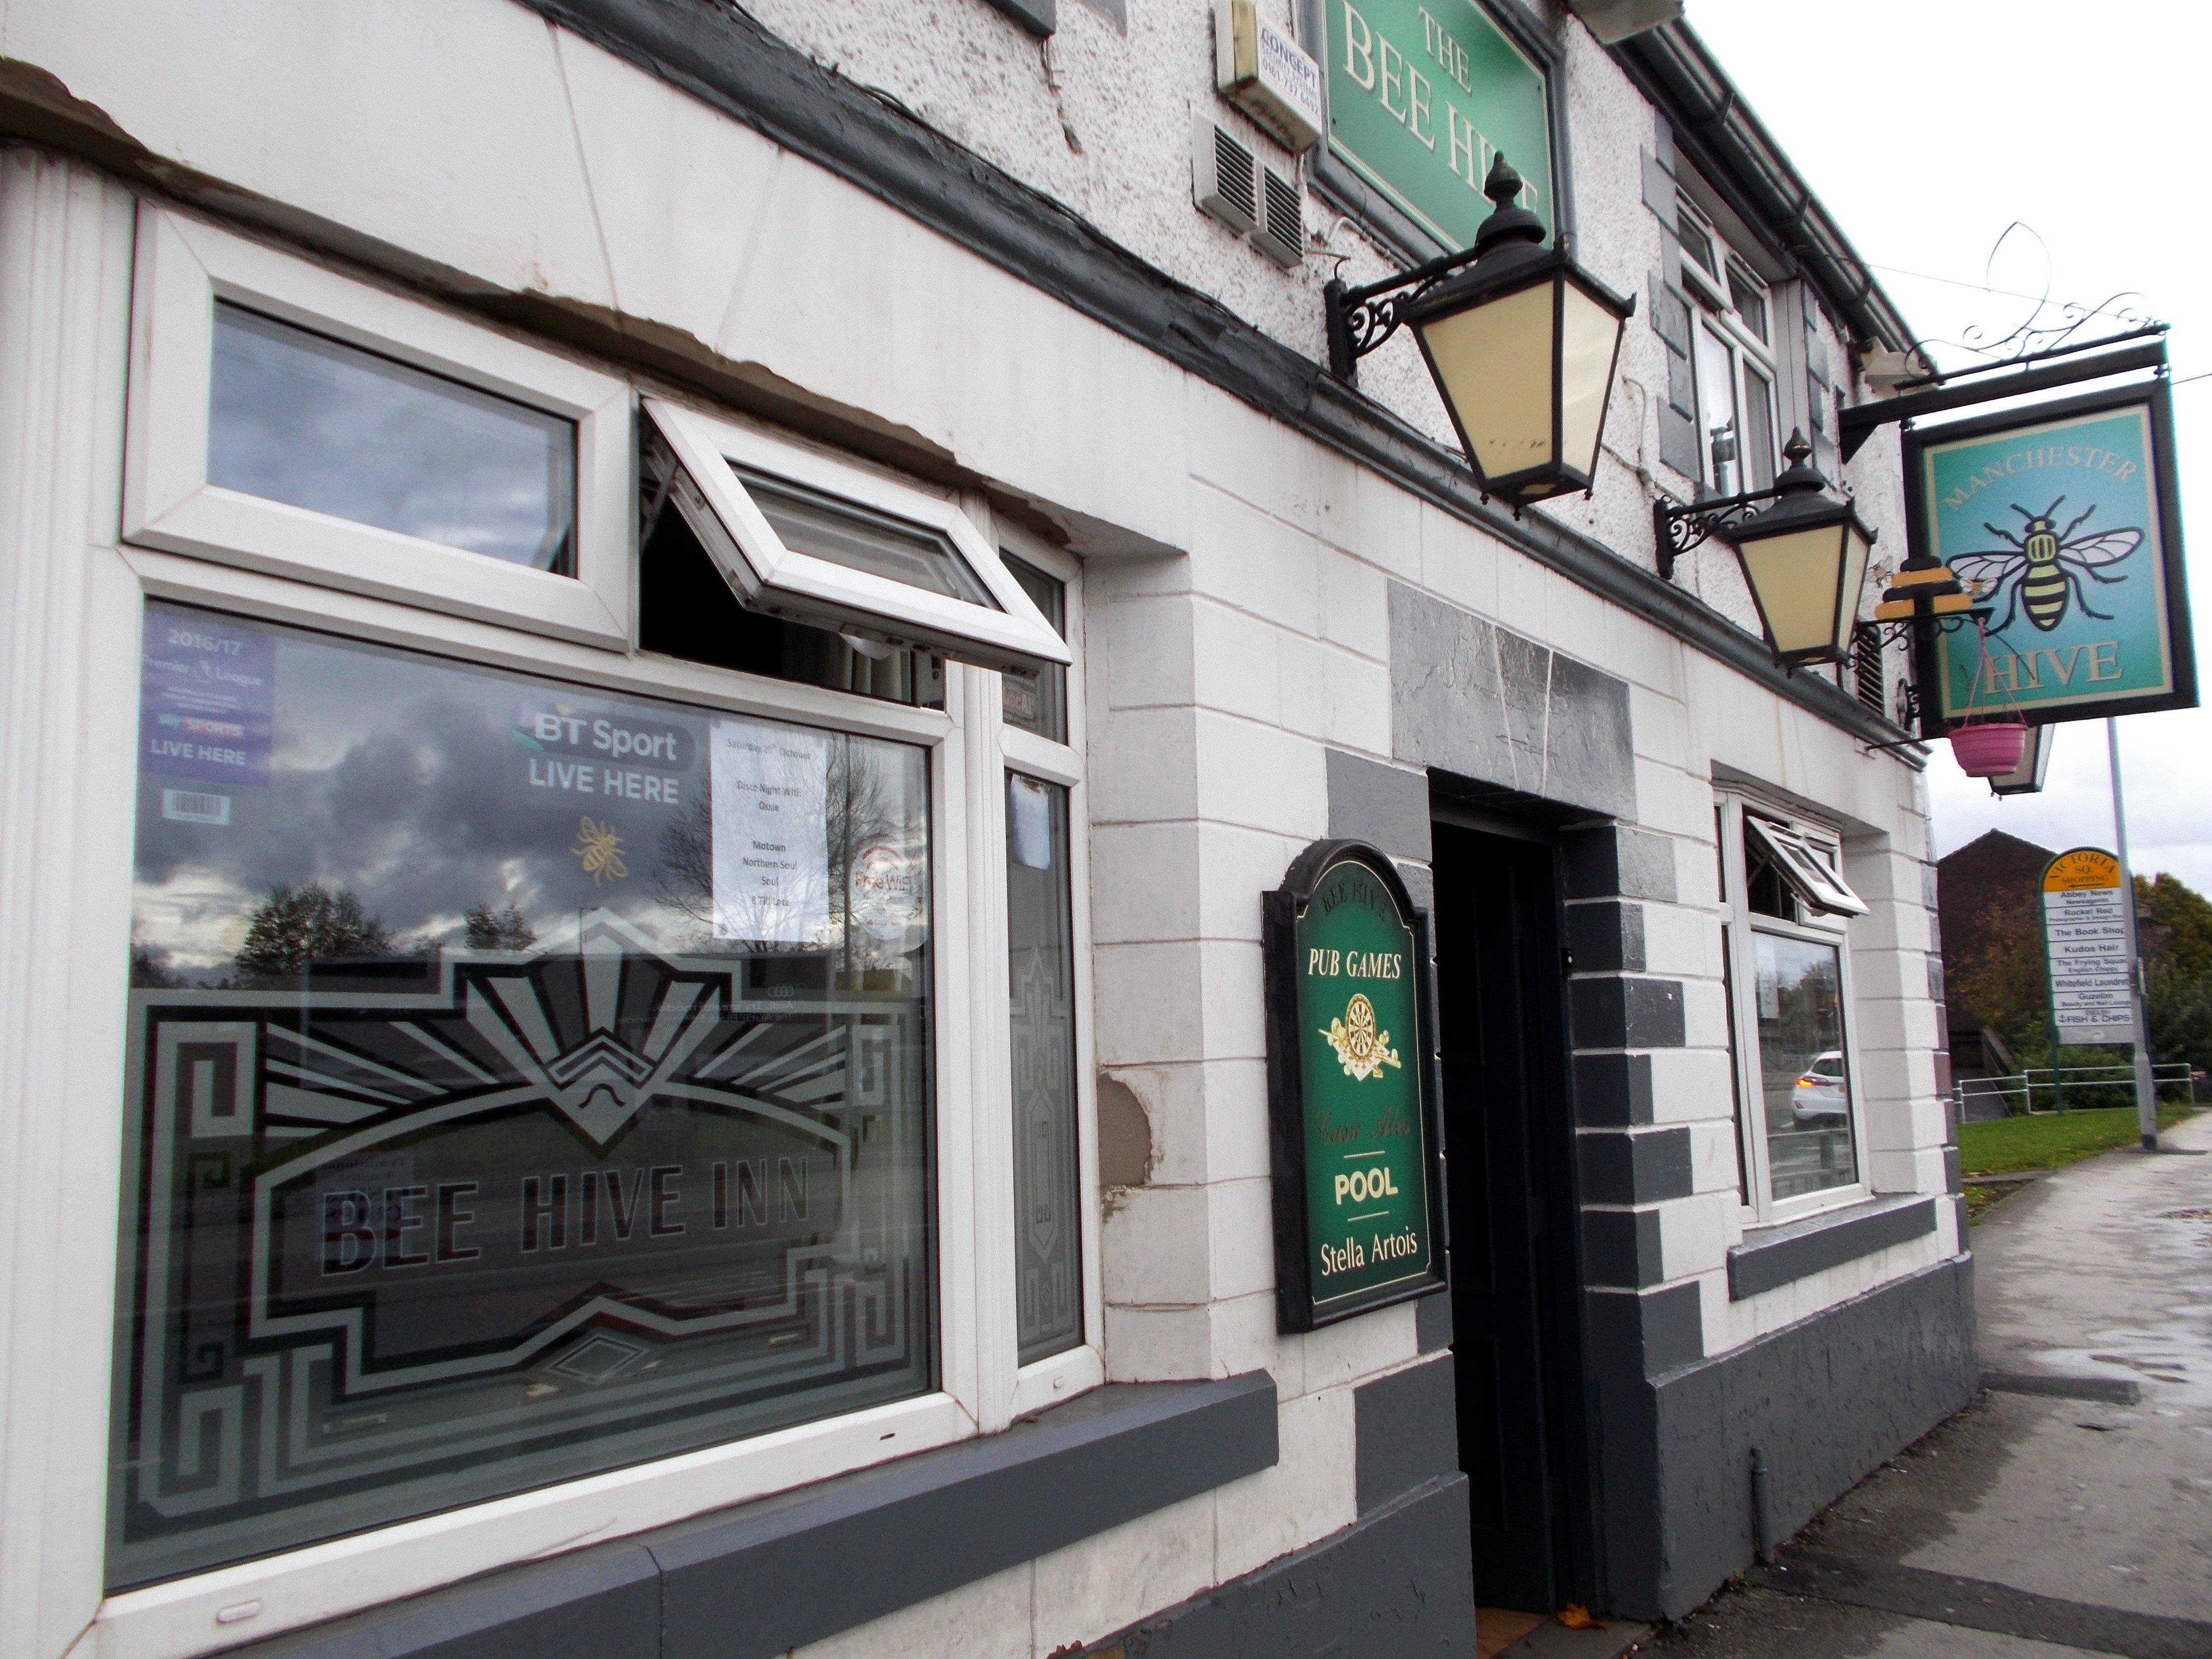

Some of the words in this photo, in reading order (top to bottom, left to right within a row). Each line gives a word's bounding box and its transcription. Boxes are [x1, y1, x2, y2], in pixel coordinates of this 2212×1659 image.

[1261, 27, 1316, 88] CONCEPT
[1418, 4, 1473, 95] THE
[1342, 0, 1436, 151] BEE
[1945, 446, 2138, 512] MANCHESTER
[167, 628, 243, 655] 2016/17
[1983, 640, 2124, 695] HIVE
[534, 712, 587, 744] BT
[592, 719, 678, 761] Sport
[152, 738, 193, 758] LIVE
[197, 744, 247, 766] HERE
[779, 747, 811, 759] October
[529, 757, 594, 793] LIVE
[603, 768, 680, 805] HERE
[737, 780, 757, 792] Disco
[759, 783, 781, 796] Night
[759, 801, 779, 812] Ossie
[752, 840, 786, 852] Motown
[742, 856, 778, 869] Northern
[780, 860, 797, 870] Soul
[2048, 853, 2116, 878] VICTORIA
[761, 876, 779, 887] Soul
[854, 871, 884, 890] Free
[2062, 875, 2109, 884] SHOPPING
[2099, 943, 2119, 951] Hair
[1307, 948, 1340, 976] PUB
[1346, 950, 1402, 979] GAMES
[1335, 1166, 1399, 1205] POOL
[320, 1179, 482, 1277] BEE
[520, 1163, 687, 1254] HIVE
[711, 1155, 809, 1232] INN
[1321, 1236, 1366, 1277] Stella
[1371, 1225, 1418, 1263] Artois
